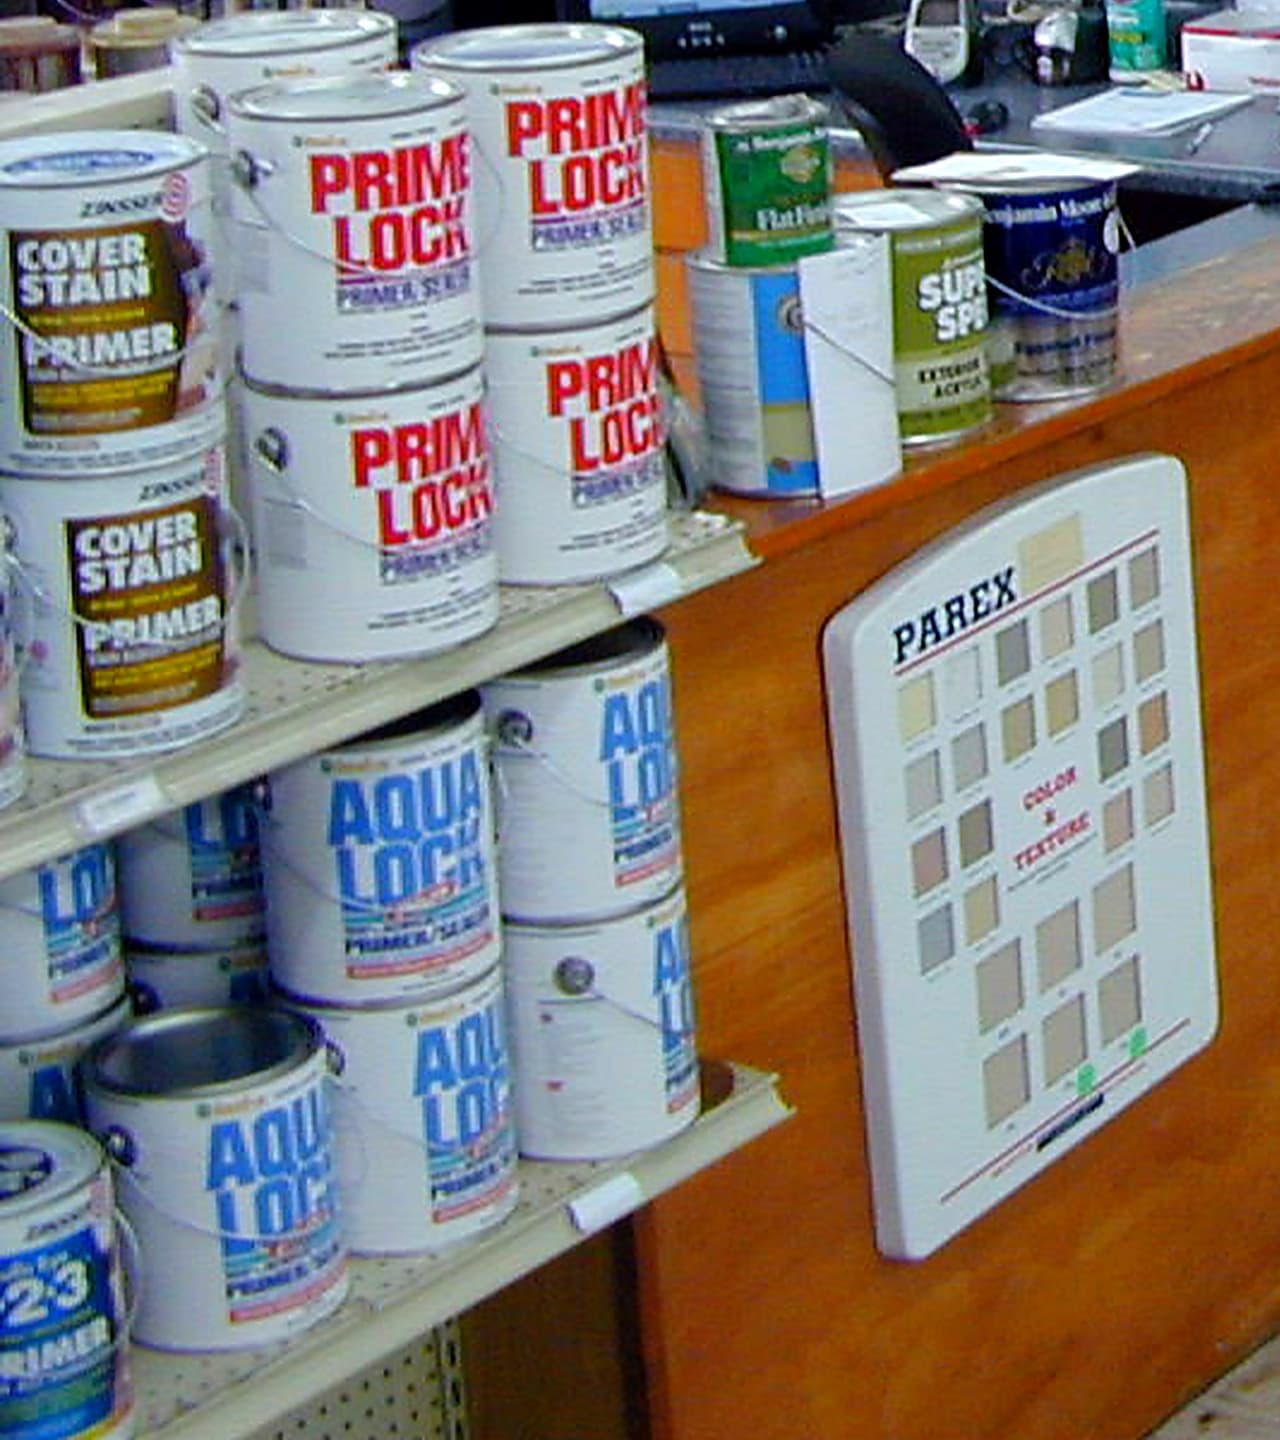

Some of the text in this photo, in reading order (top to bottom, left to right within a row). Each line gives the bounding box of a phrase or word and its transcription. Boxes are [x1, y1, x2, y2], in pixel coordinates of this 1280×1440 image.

[310, 130, 470, 214] PRIME
[531, 140, 645, 214] LOCK
[18, 233, 147, 271] COVER
[335, 194, 470, 274] LOCK
[19, 265, 151, 306] STAIN
[918, 260, 987, 311] SUP
[23, 322, 178, 368] PRIMER
[546, 337, 660, 417] PRIM
[353, 402, 485, 488] PRIM
[76, 511, 198, 560] COVER
[376, 462, 493, 546] LOCK
[78, 539, 203, 594] STAIN
[84, 594, 223, 653] PRIMER
[893, 565, 1018, 665] PAREX
[601, 675, 672, 762] AQ
[327, 750, 482, 846] AQUA
[610, 744, 675, 822] LO
[1021, 764, 1077, 810] COLOR
[1013, 811, 1091, 871] TEXTURE
[412, 1003, 510, 1097] AQU
